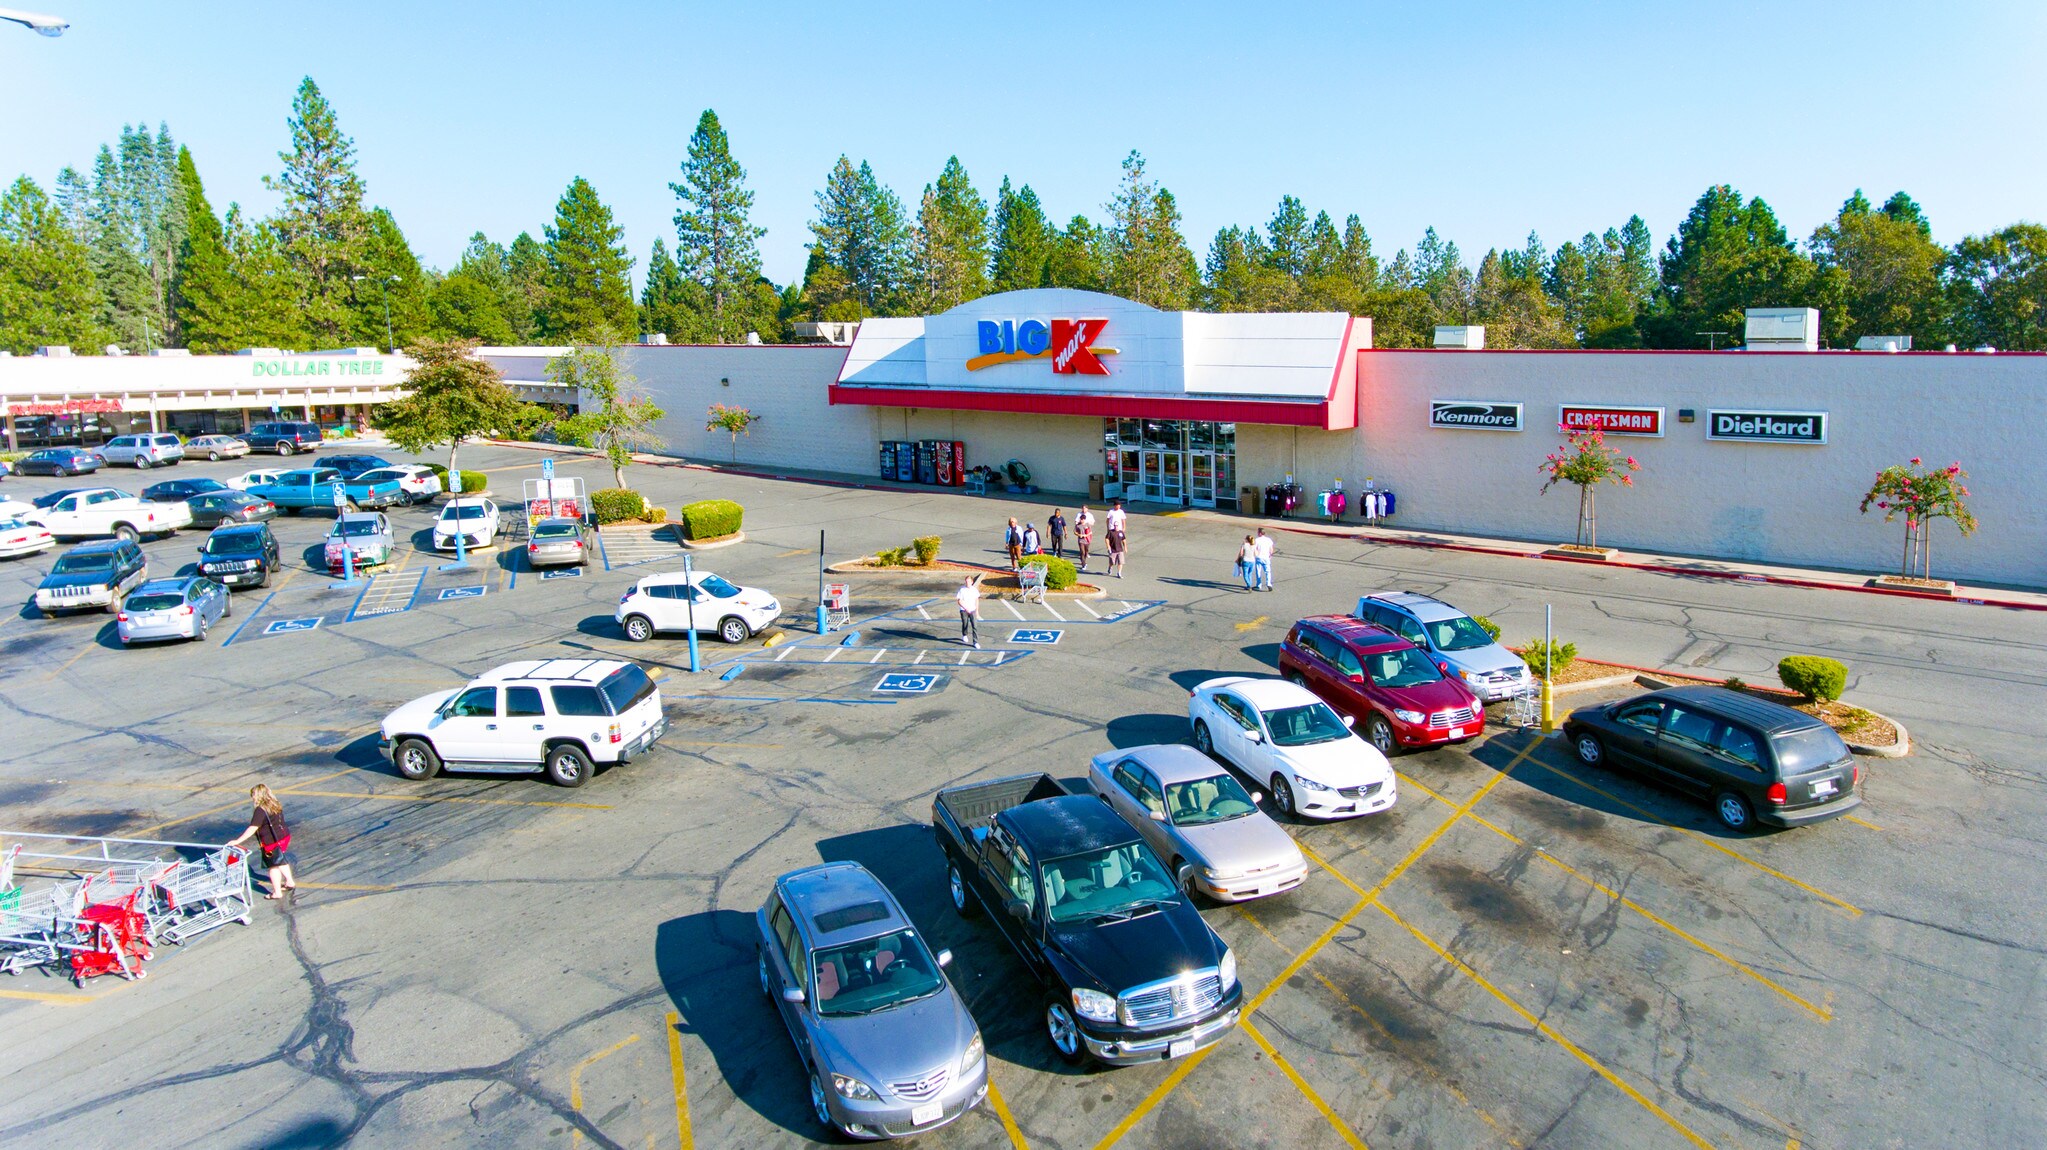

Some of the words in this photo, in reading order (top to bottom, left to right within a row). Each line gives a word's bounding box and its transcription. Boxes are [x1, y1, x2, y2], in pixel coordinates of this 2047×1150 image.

[978, 318, 1049, 355] BIG
[1051, 317, 1111, 376] K
[1055, 322, 1086, 371] mart
[253, 361, 331, 377] DOLLAR
[338, 360, 383, 375] TREE
[67, 398, 123, 415] PIZZA
[1435, 411, 1514, 425] Kenmore
[1567, 412, 1651, 428] CRAFTSMAN
[1718, 416, 1814, 436] DieHard
